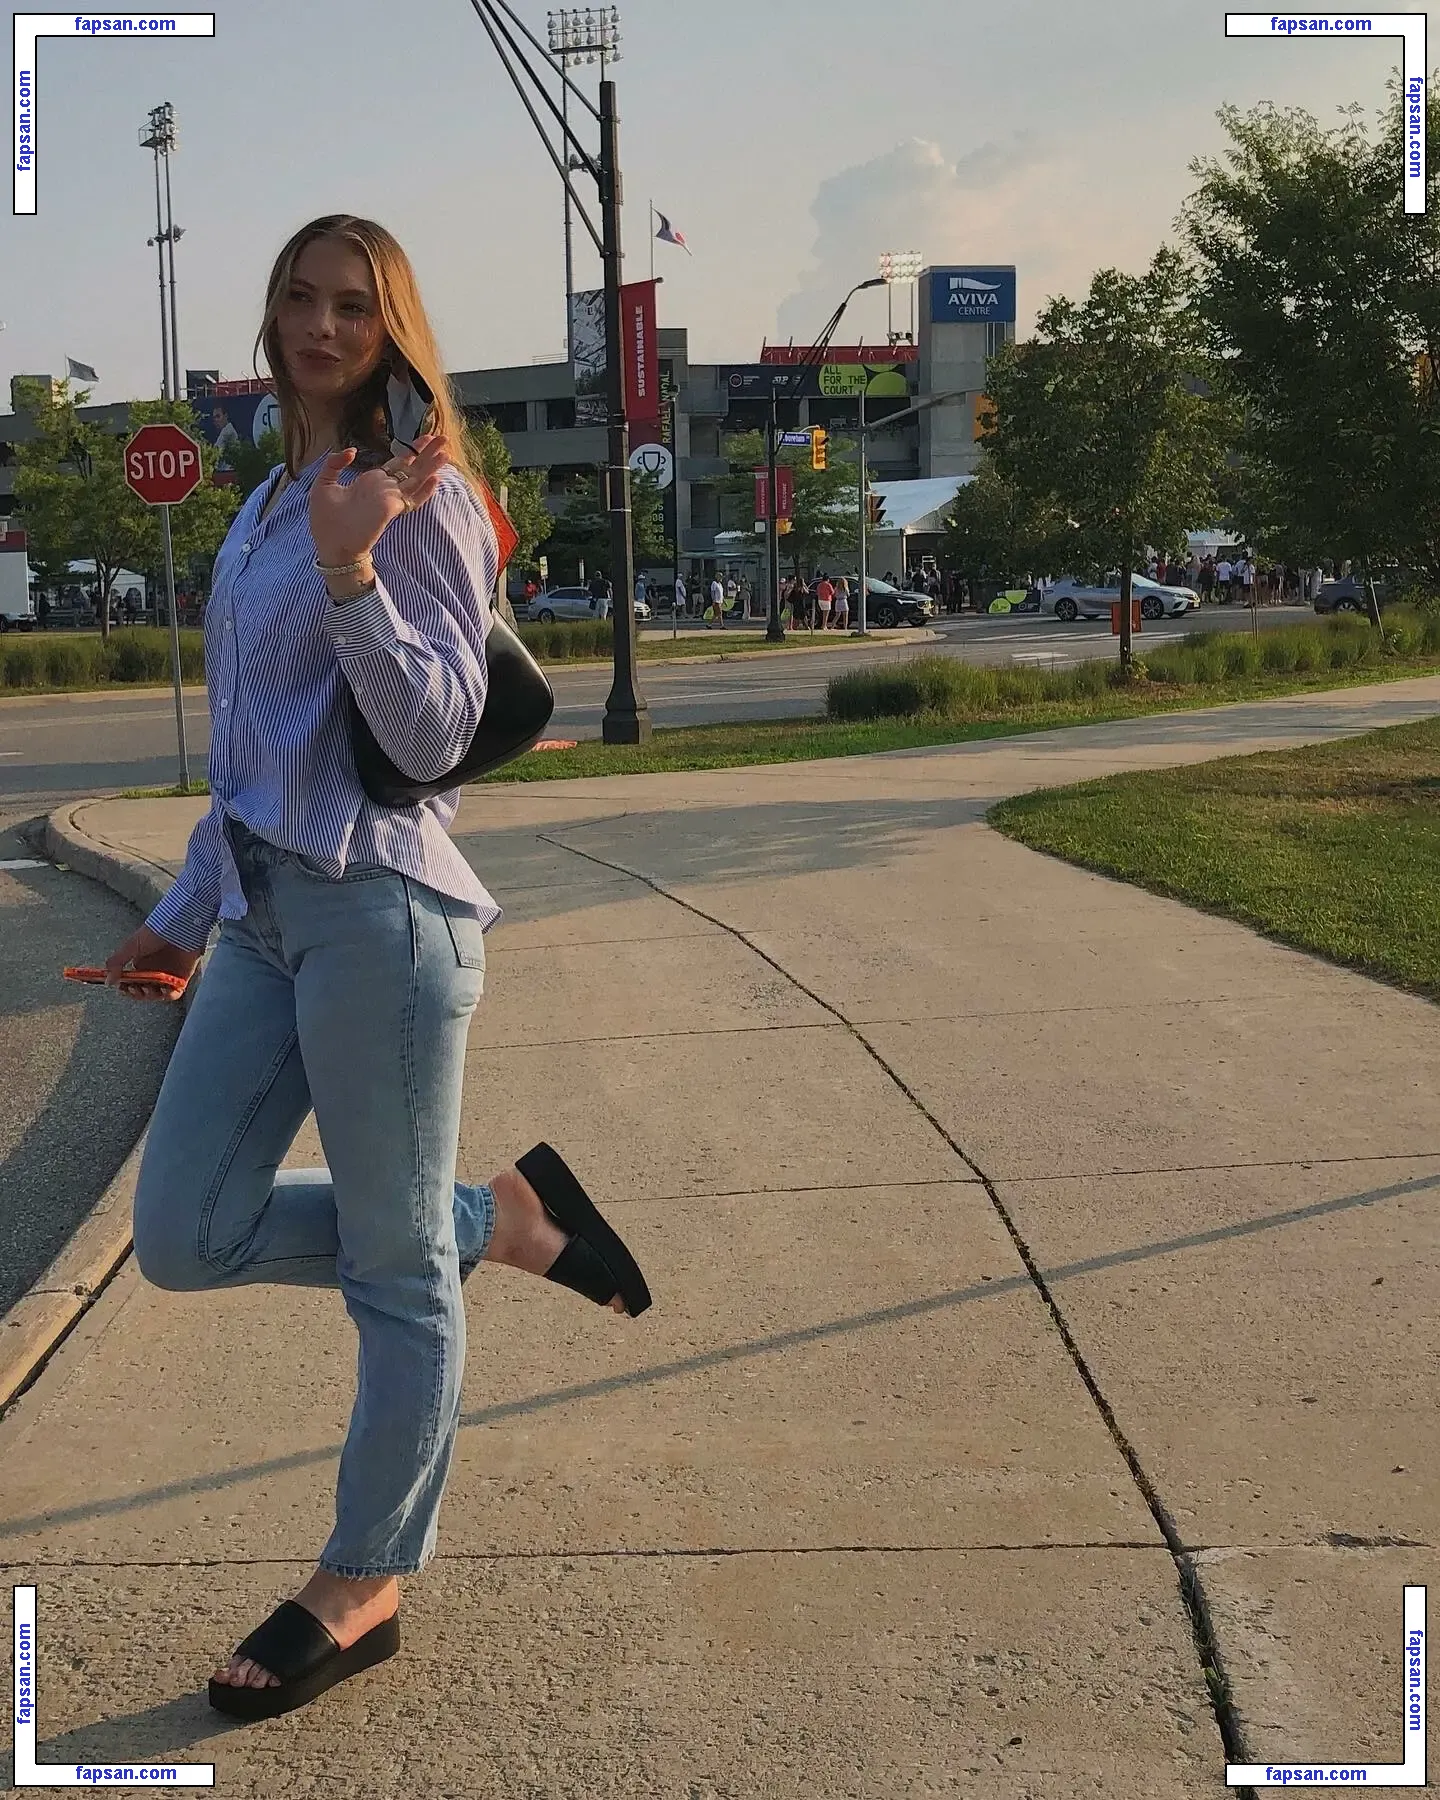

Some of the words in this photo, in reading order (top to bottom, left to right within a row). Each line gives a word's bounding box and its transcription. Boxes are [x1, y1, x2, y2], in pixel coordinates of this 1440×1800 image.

[948, 293, 999, 305] AVIVA
[958, 306, 991, 315] CENTRE
[635, 305, 646, 398] SUSTAINABLE
[823, 365, 842, 375] ALL
[660, 369, 671, 402] NADAL
[823, 375, 842, 385] FOR
[848, 375, 866, 385] THE
[130, 450, 195, 480] STOP
